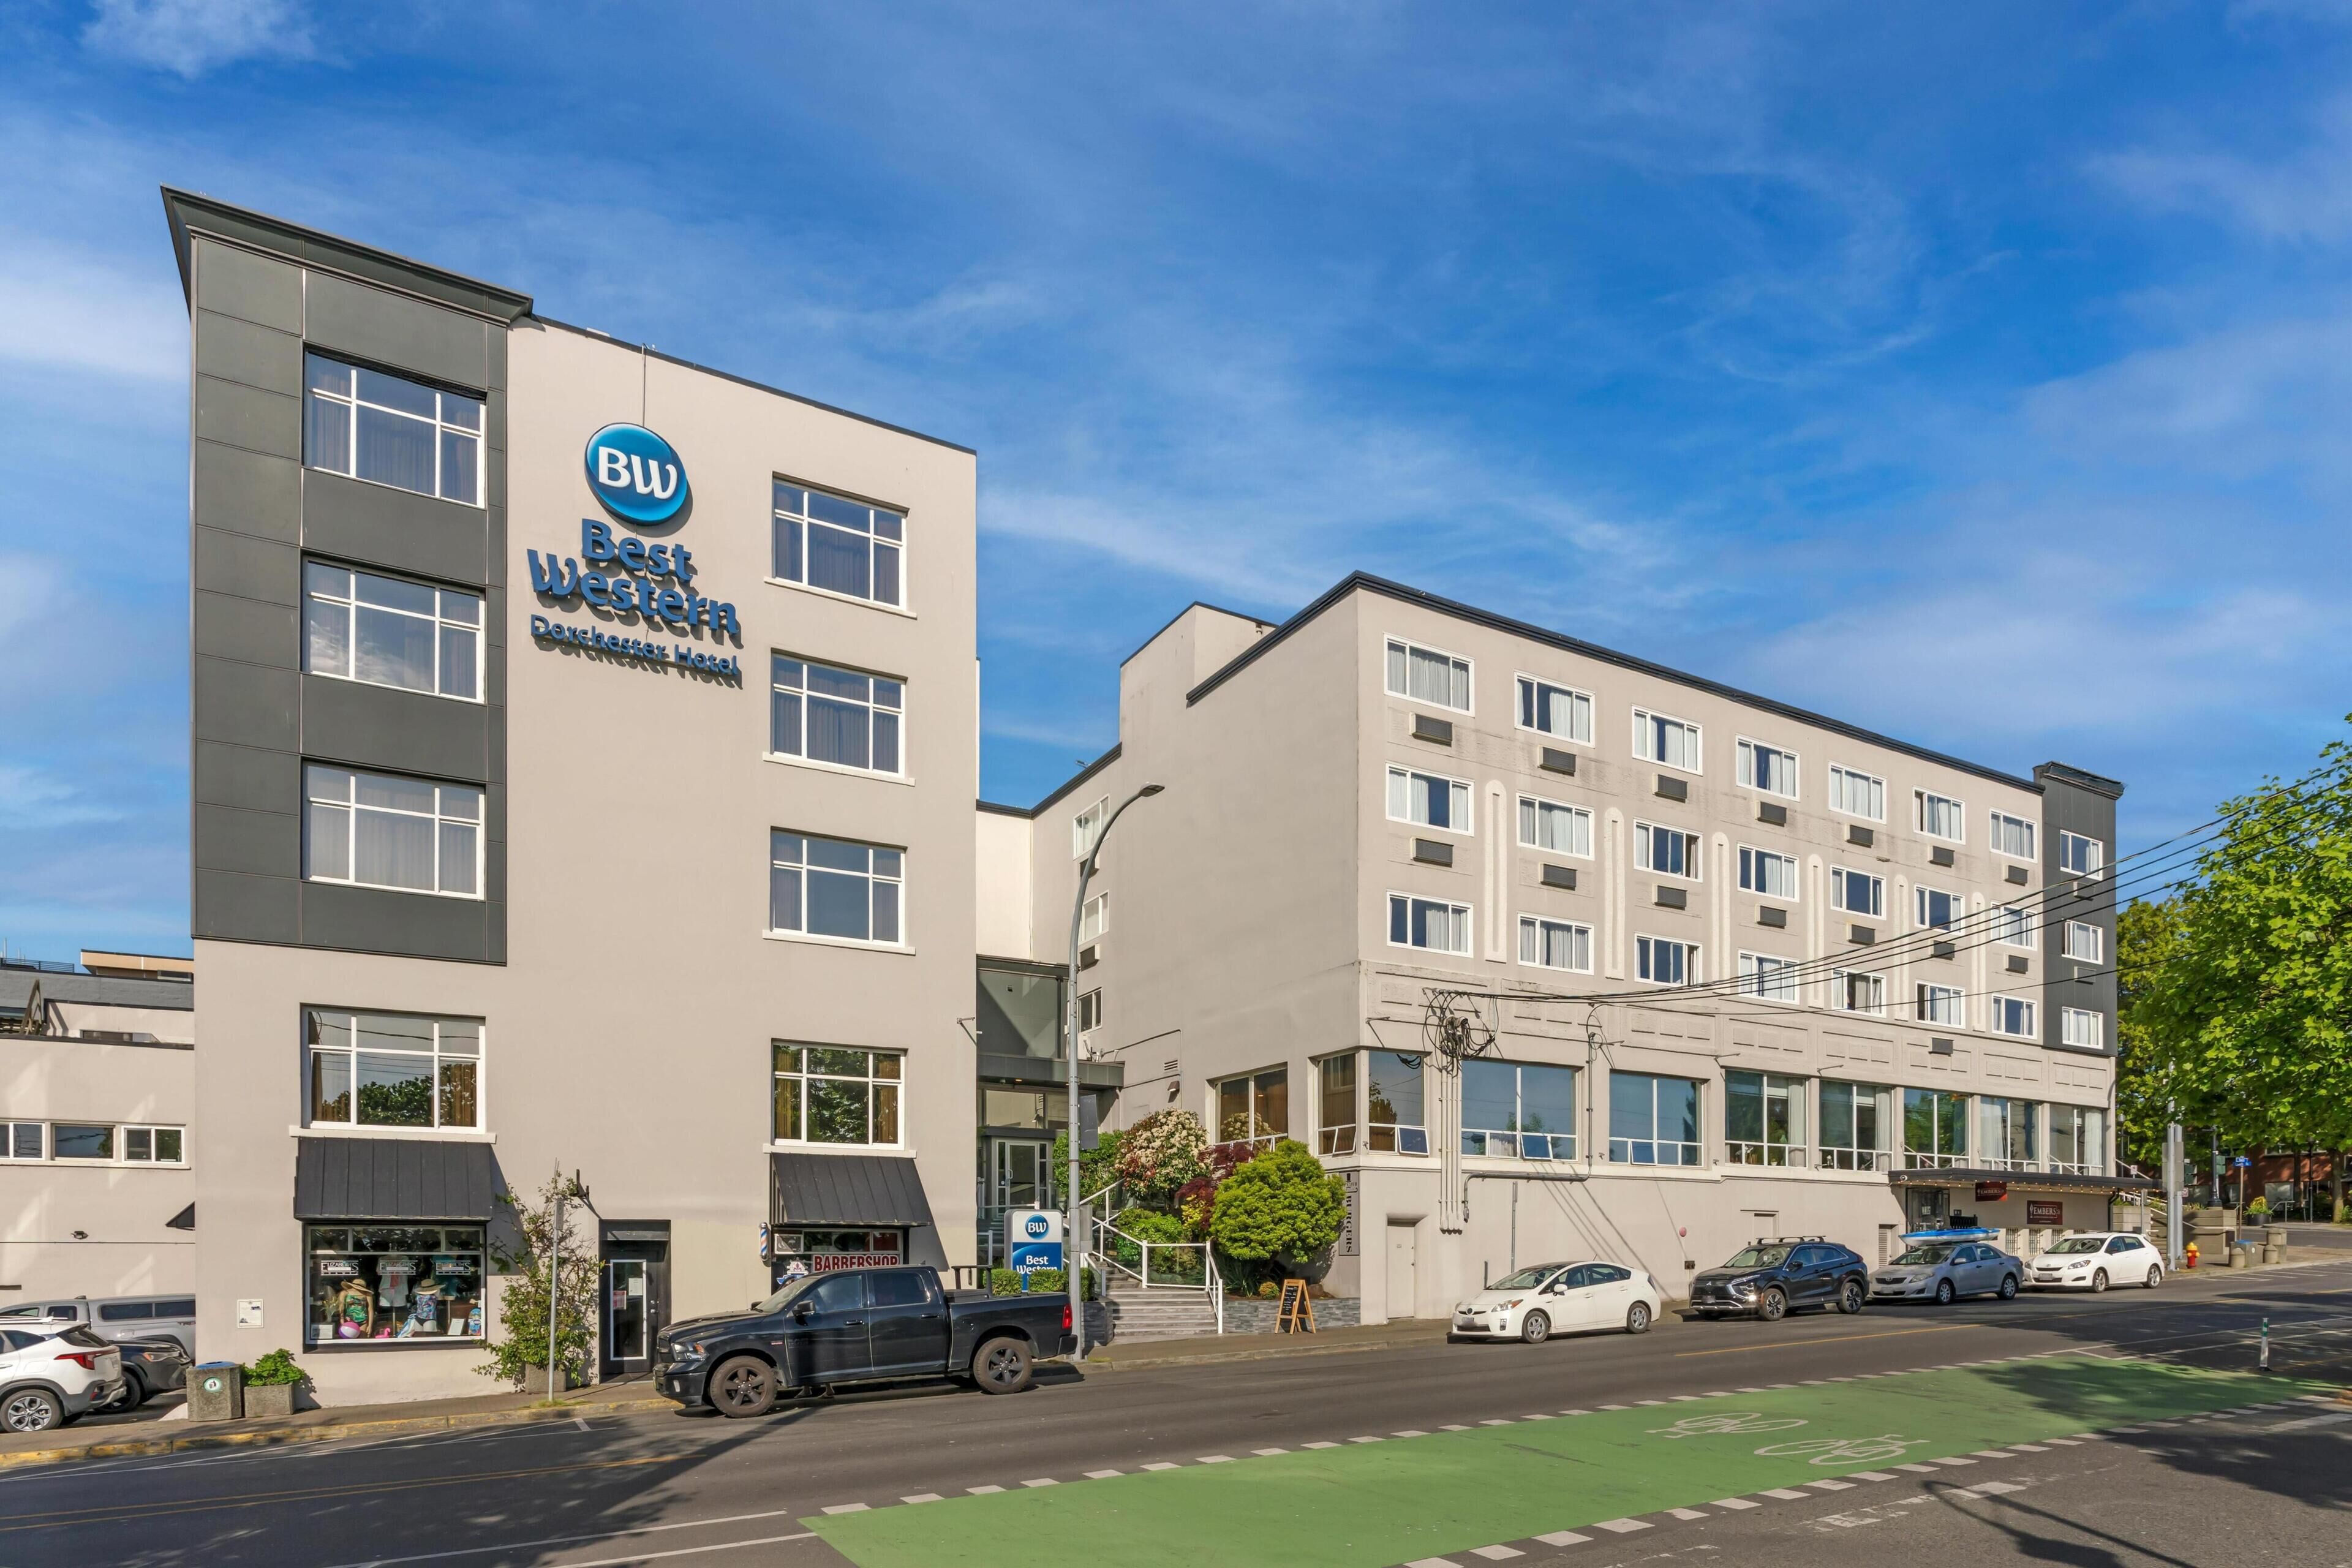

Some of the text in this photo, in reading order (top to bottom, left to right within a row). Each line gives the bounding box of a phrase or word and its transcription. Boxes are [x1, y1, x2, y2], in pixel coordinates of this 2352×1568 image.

[598, 446, 677, 499] BW
[581, 518, 693, 582] Best
[526, 548, 739, 635] Western
[530, 614, 738, 676] Dorchester Hotel
[1028, 1222, 1047, 1233] BW
[2034, 1207, 2056, 1215] EMBERS
[1026, 1255, 1049, 1265] Best
